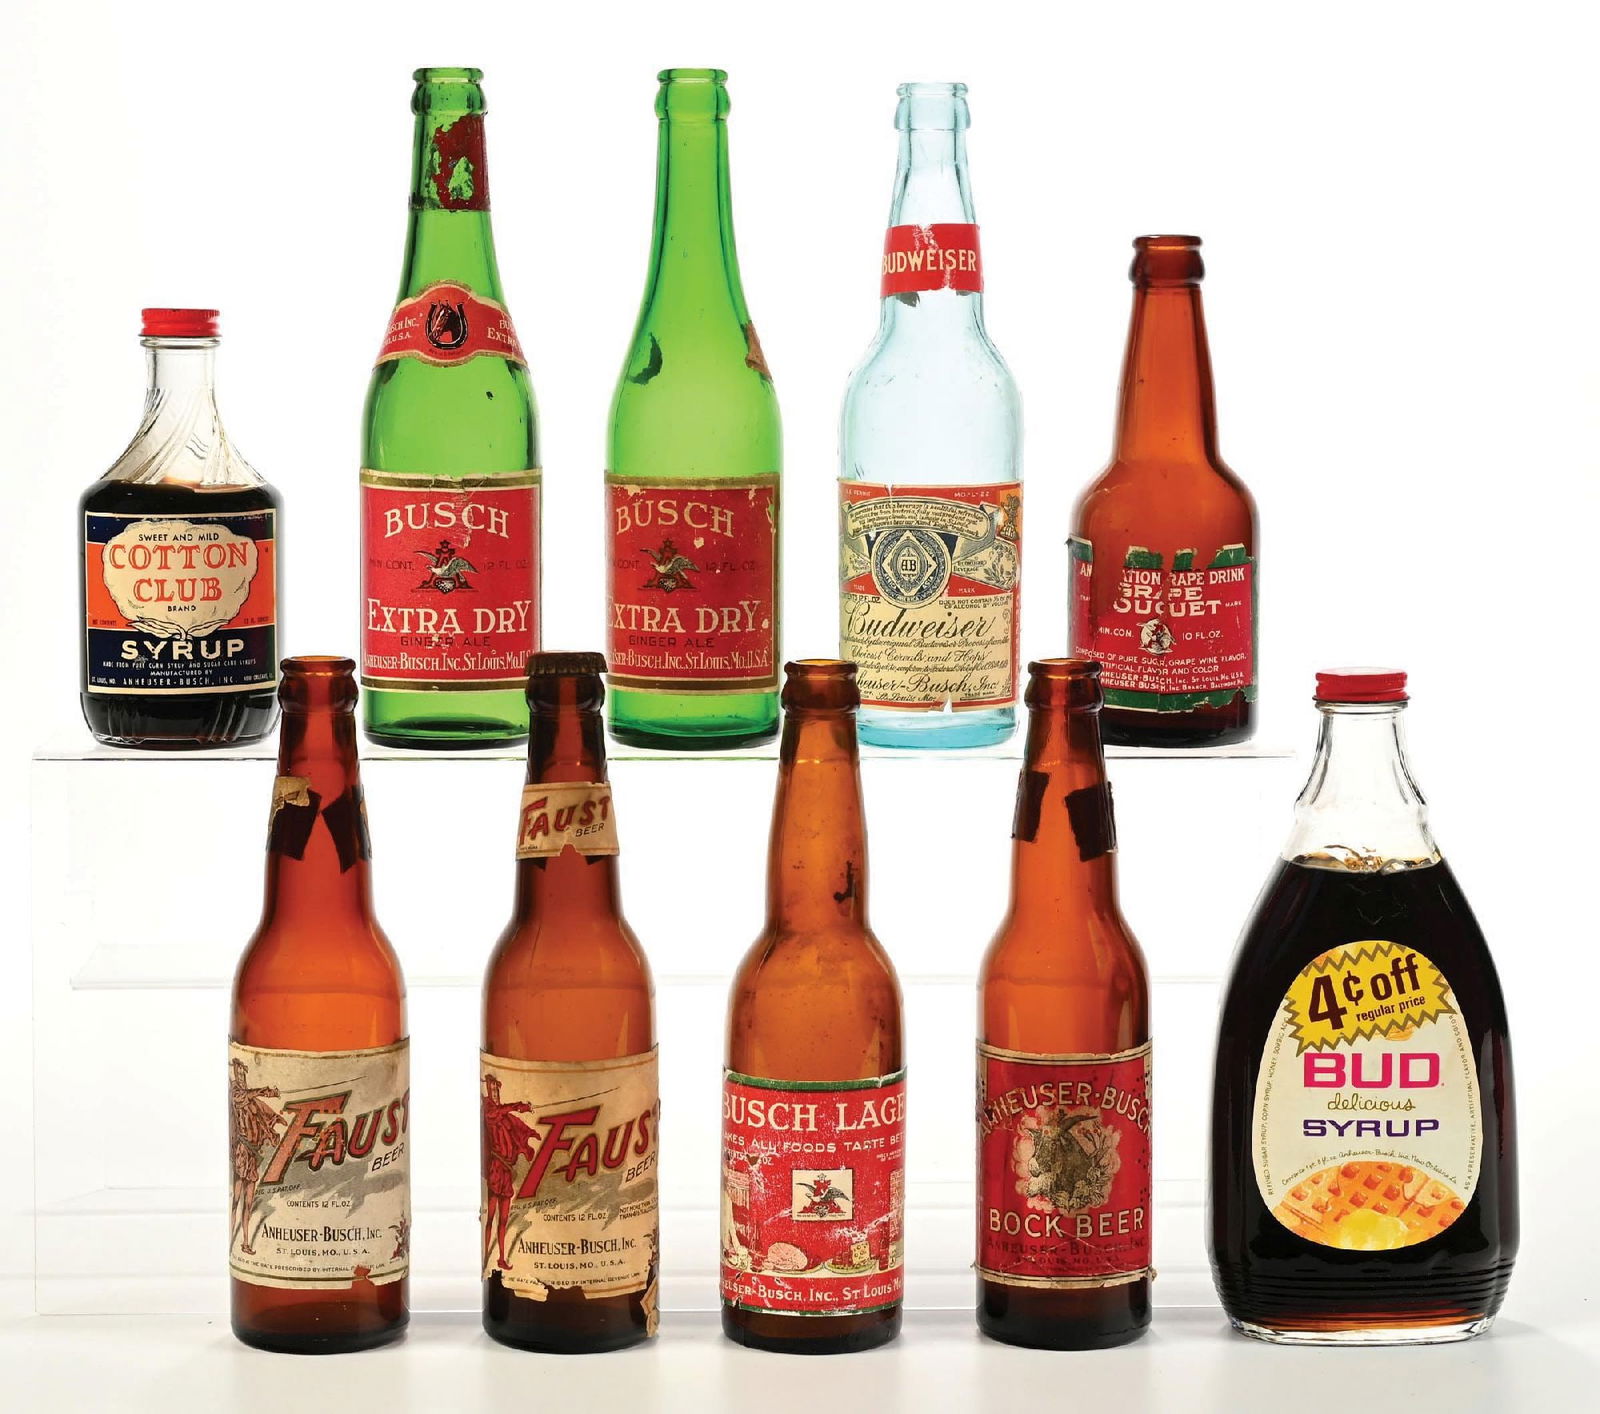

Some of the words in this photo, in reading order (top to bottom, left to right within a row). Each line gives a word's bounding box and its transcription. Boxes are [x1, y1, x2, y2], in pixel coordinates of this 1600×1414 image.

[882, 249, 976, 275] BUDWEISER
[384, 502, 509, 538] BUSCH
[616, 500, 734, 538] BUSCH
[138, 534, 168, 542] SWEET
[172, 533, 192, 541] AND
[109, 542, 248, 570] COTTON
[1171, 572, 1205, 586] RAPE
[1209, 568, 1245, 584] DRINK
[133, 578, 223, 602] CLUB
[368, 599, 464, 634] EXTRA
[473, 600, 531, 634] DRY
[606, 596, 686, 634] EXTRA
[696, 600, 761, 634] DRY
[1113, 599, 1222, 617] OUQUET
[845, 600, 996, 638] Budweiser
[464, 636, 490, 647] ALE
[629, 635, 676, 646] GINGER
[684, 637, 715, 648] ALE
[1182, 632, 1192, 640] 10
[121, 639, 244, 660] SYRUP
[1076, 646, 1104, 659] COMPOSED
[1169, 658, 1195, 666] GRAPE
[1138, 666, 1168, 675] FLAVOR
[123, 678, 214, 686] ANHEUSER-BUSCH,
[856, 672, 971, 693] heuser-Busch,
[520, 796, 610, 846] FAUST
[576, 823, 605, 838] BEER
[1370, 953, 1420, 1001] off
[1356, 1000, 1396, 1022] regular
[1399, 995, 1425, 1013] price
[1304, 1052, 1440, 1089] BUD
[722, 1091, 818, 1131] BUSCH
[1327, 1093, 1416, 1111] delicious
[1303, 1119, 1439, 1137] SYRUP
[784, 1142, 836, 1152] FOODS
[844, 1137, 884, 1151] TASTE
[371, 1143, 405, 1172] BEER
[625, 1152, 656, 1183] BEER
[543, 1214, 576, 1222] CONTENTS
[989, 1208, 1064, 1238] BOCK
[1076, 1208, 1144, 1238] BEER
[262, 1223, 365, 1242] ANHEUSER-BUSCH,
[367, 1226, 382, 1240] INC.
[518, 1238, 620, 1255] ANHEUSER-BUSCH,
[622, 1237, 637, 1249] INC.
